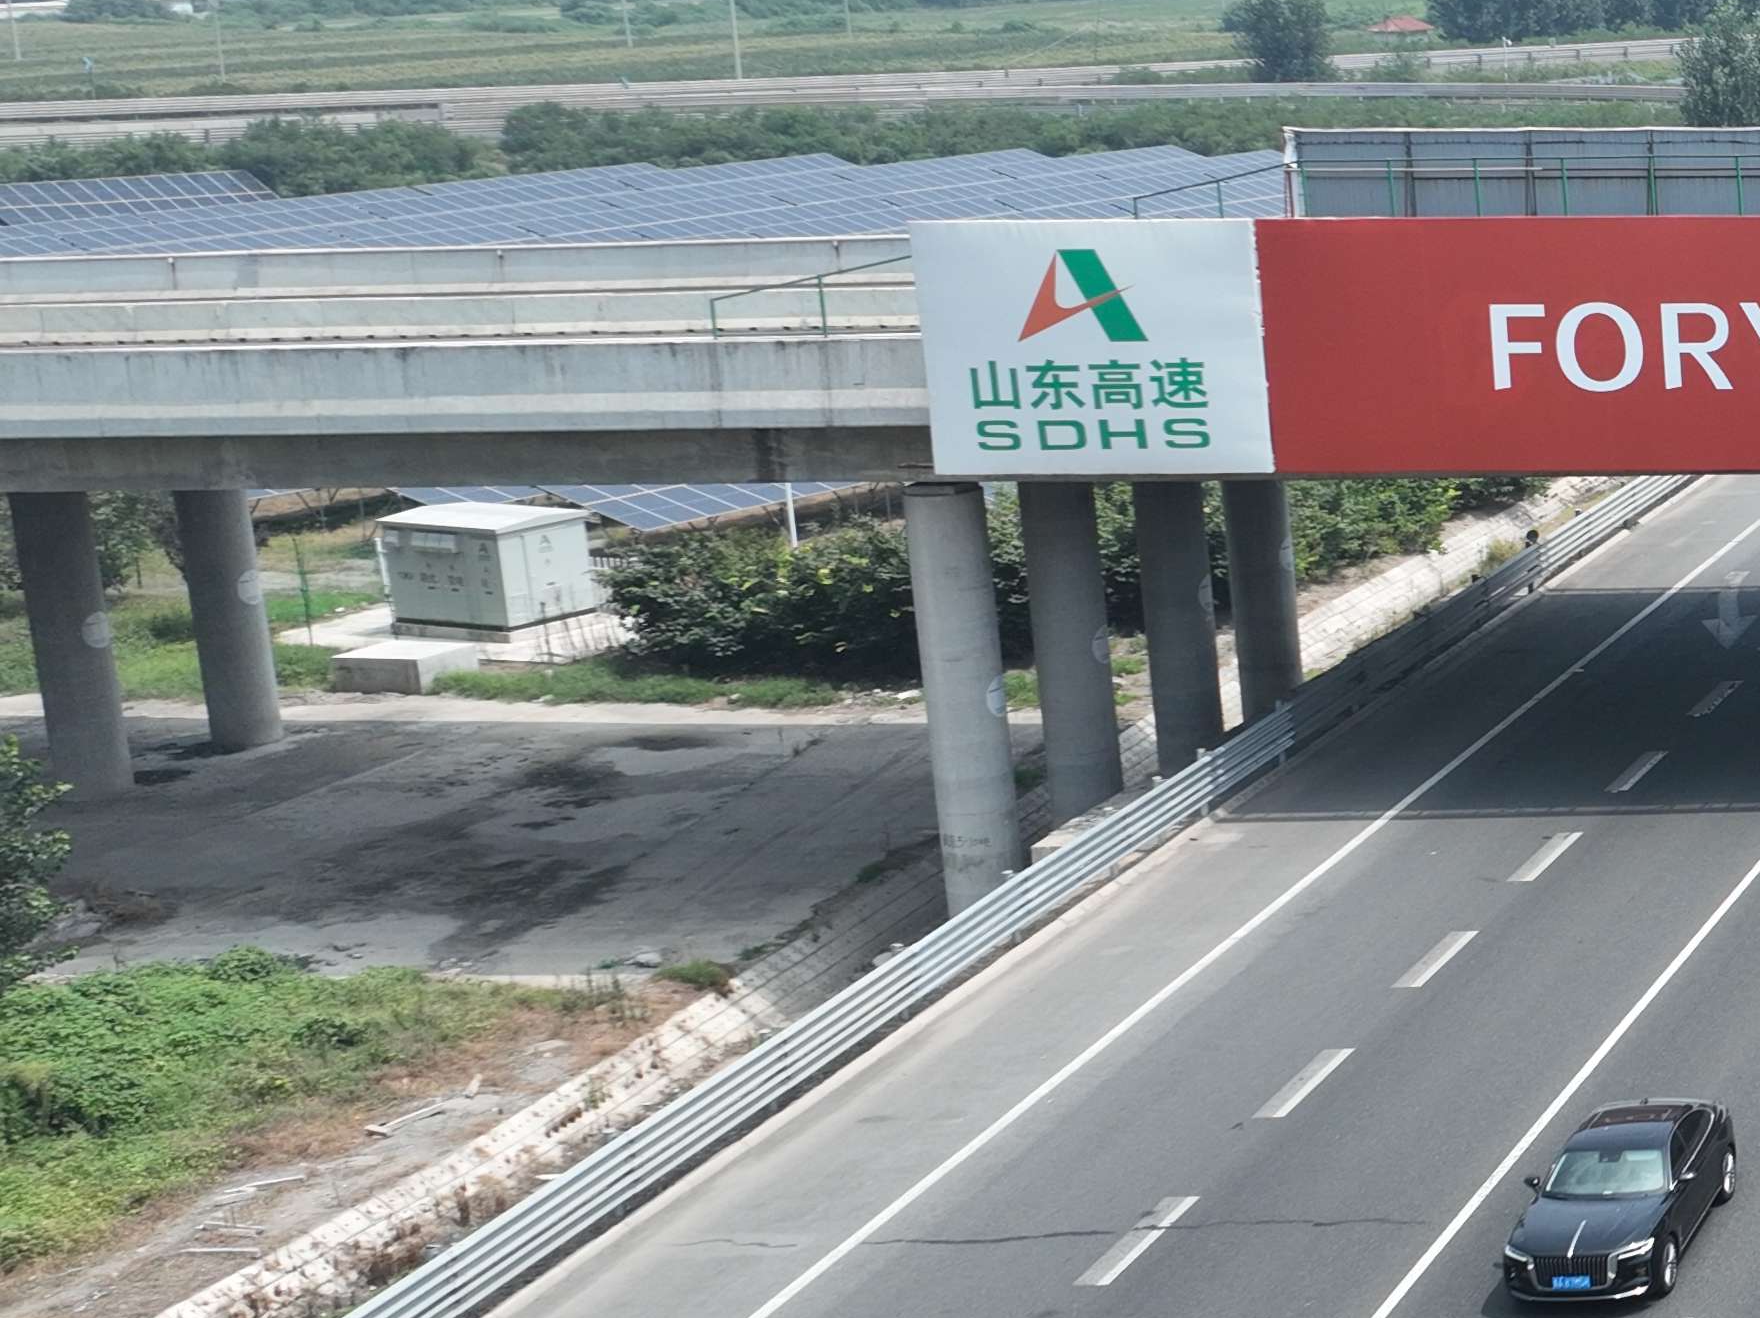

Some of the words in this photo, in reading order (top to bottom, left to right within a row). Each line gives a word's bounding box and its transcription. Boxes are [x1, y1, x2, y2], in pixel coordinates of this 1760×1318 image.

[971, 358, 1208, 409] 山东高速
[977, 419, 1209, 450] SDHS
